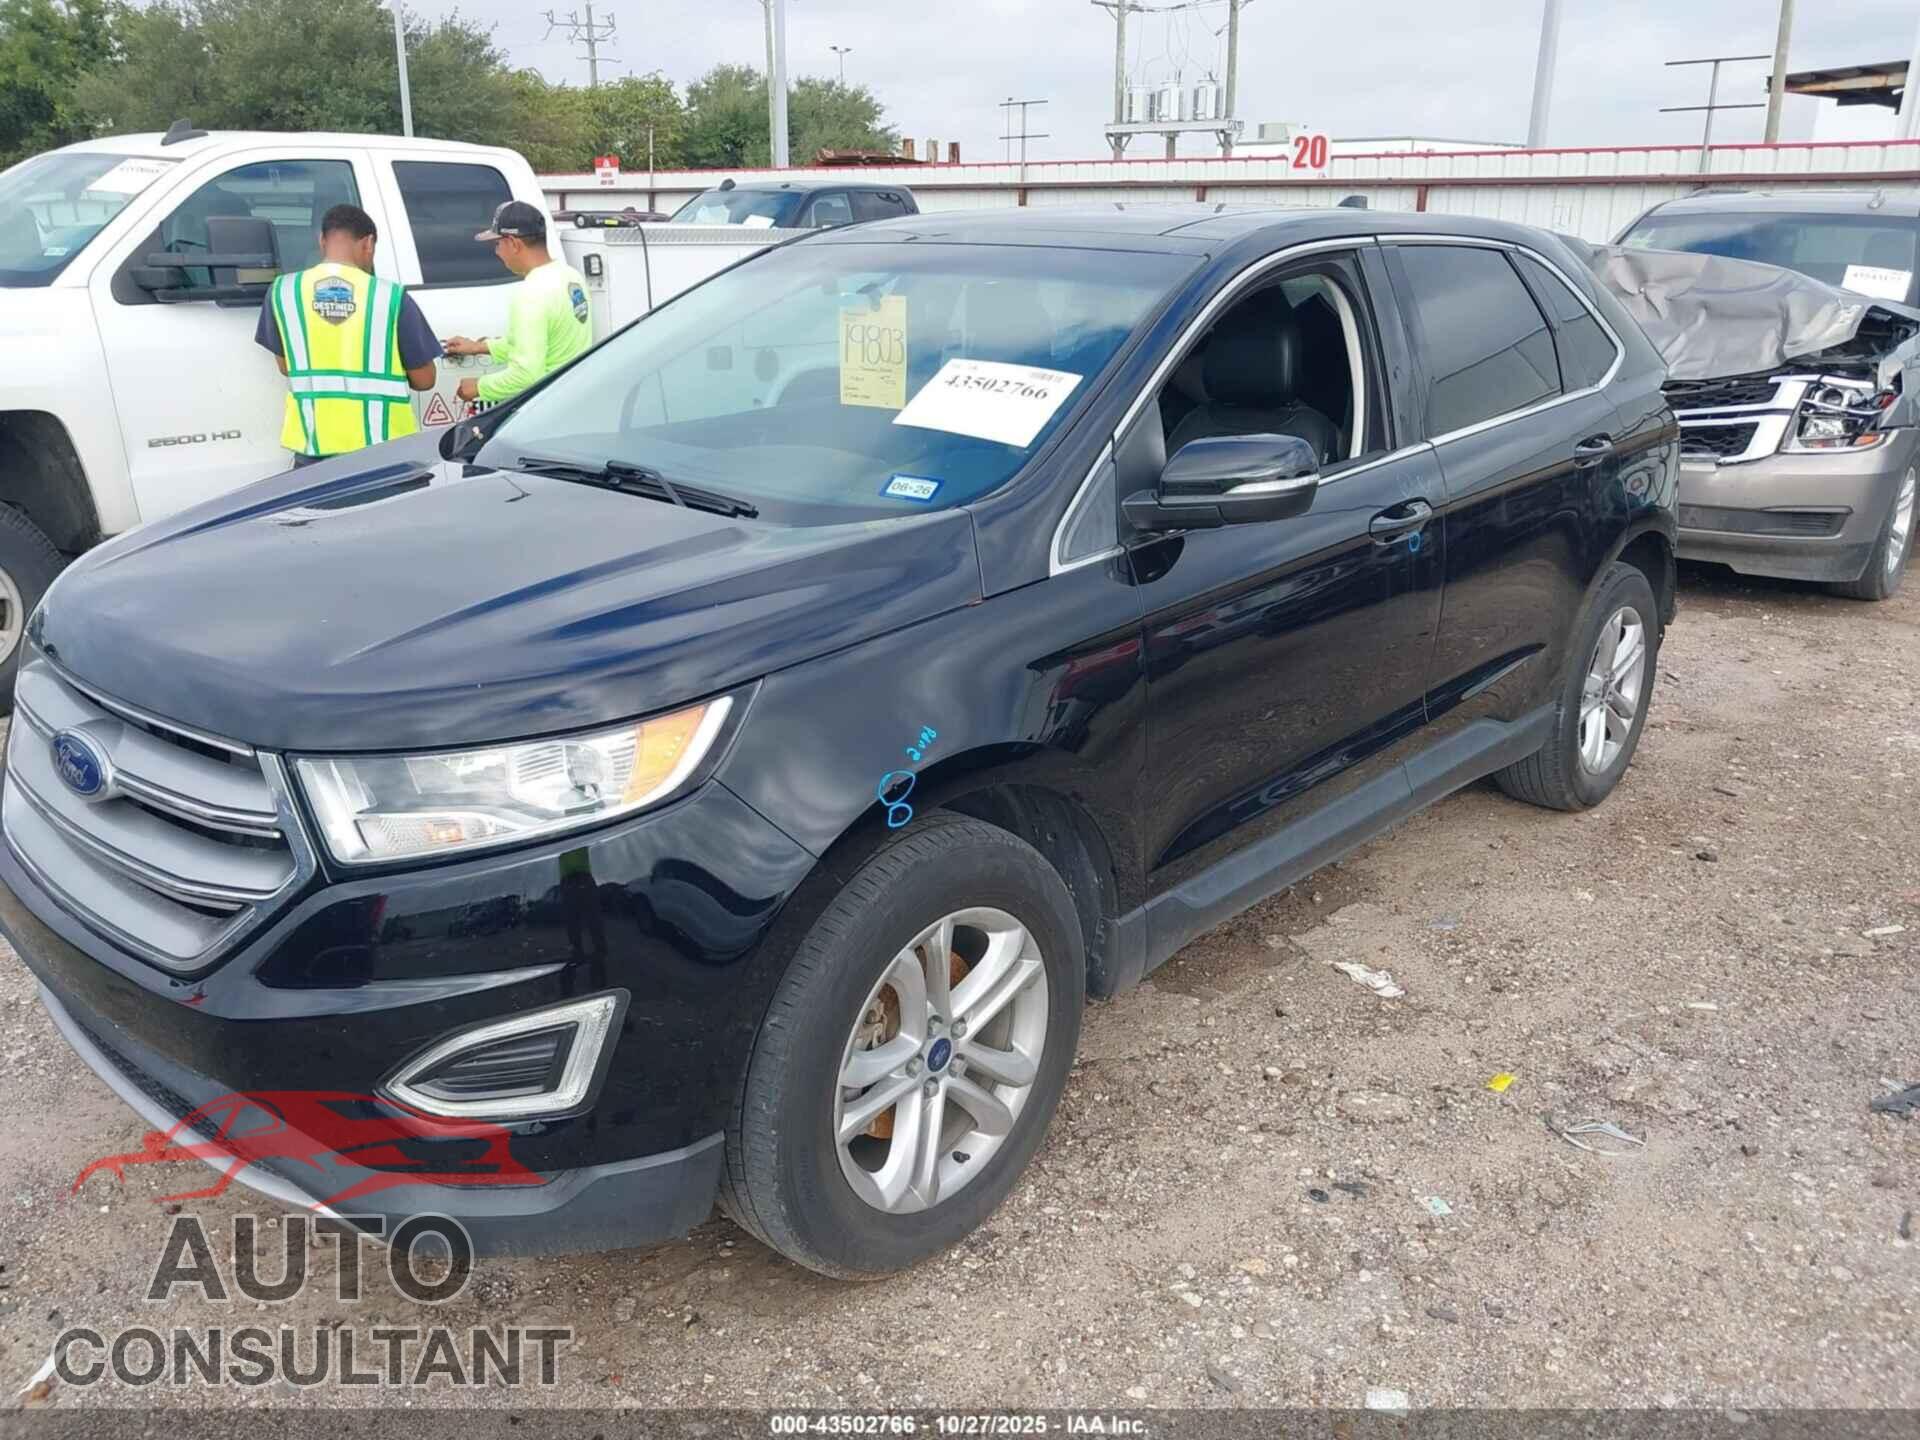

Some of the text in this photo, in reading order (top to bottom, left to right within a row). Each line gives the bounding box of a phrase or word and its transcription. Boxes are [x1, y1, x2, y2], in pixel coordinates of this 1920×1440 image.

[1293, 135, 1327, 169] 20
[845, 323, 905, 366] 19803
[944, 375, 1048, 400] 43502766
[148, 429, 242, 448] 2500 HD
[56, 743, 89, 787] Ford
